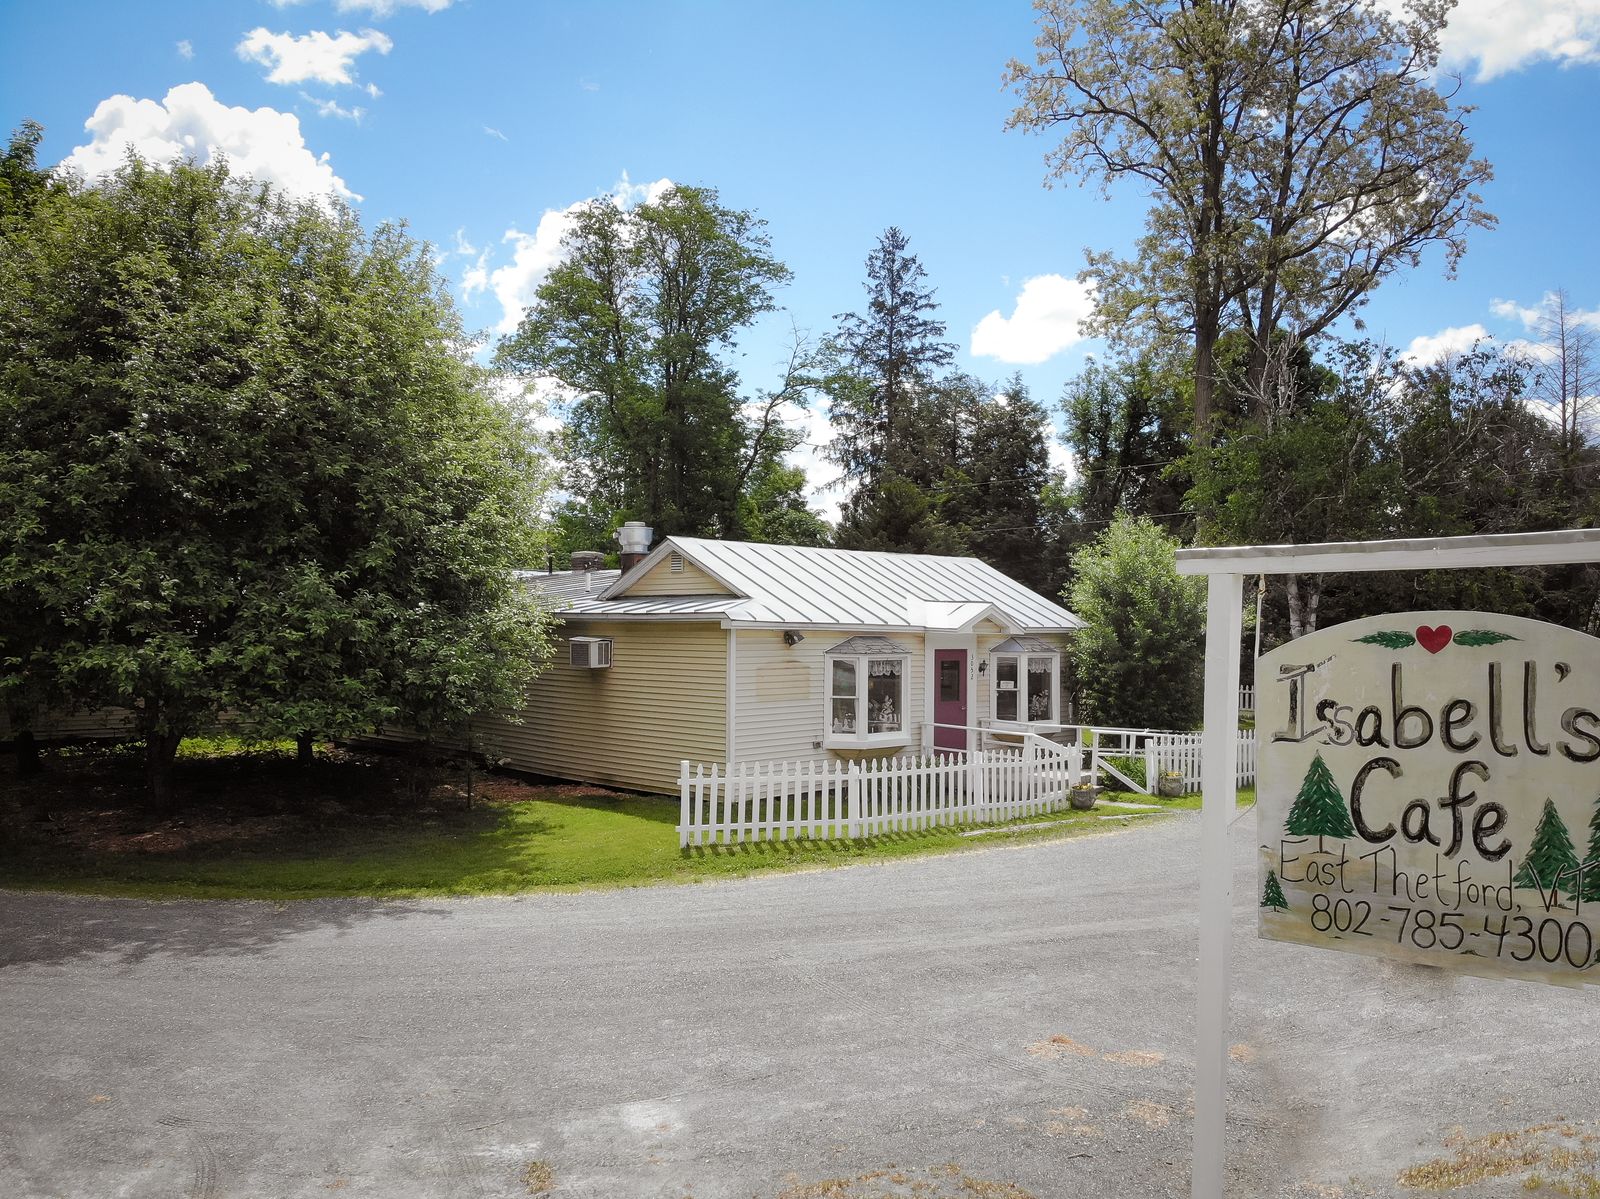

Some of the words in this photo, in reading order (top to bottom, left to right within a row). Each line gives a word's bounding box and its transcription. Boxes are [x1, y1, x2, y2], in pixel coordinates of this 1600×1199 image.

[1271, 658, 1600, 763] Isabell's
[1351, 756, 1513, 861] Cafe
[1280, 838, 1354, 893] East
[1359, 844, 1522, 913] Thetford,
[1526, 860, 1600, 916] VT
[1311, 893, 1593, 969] 802-785-4300
